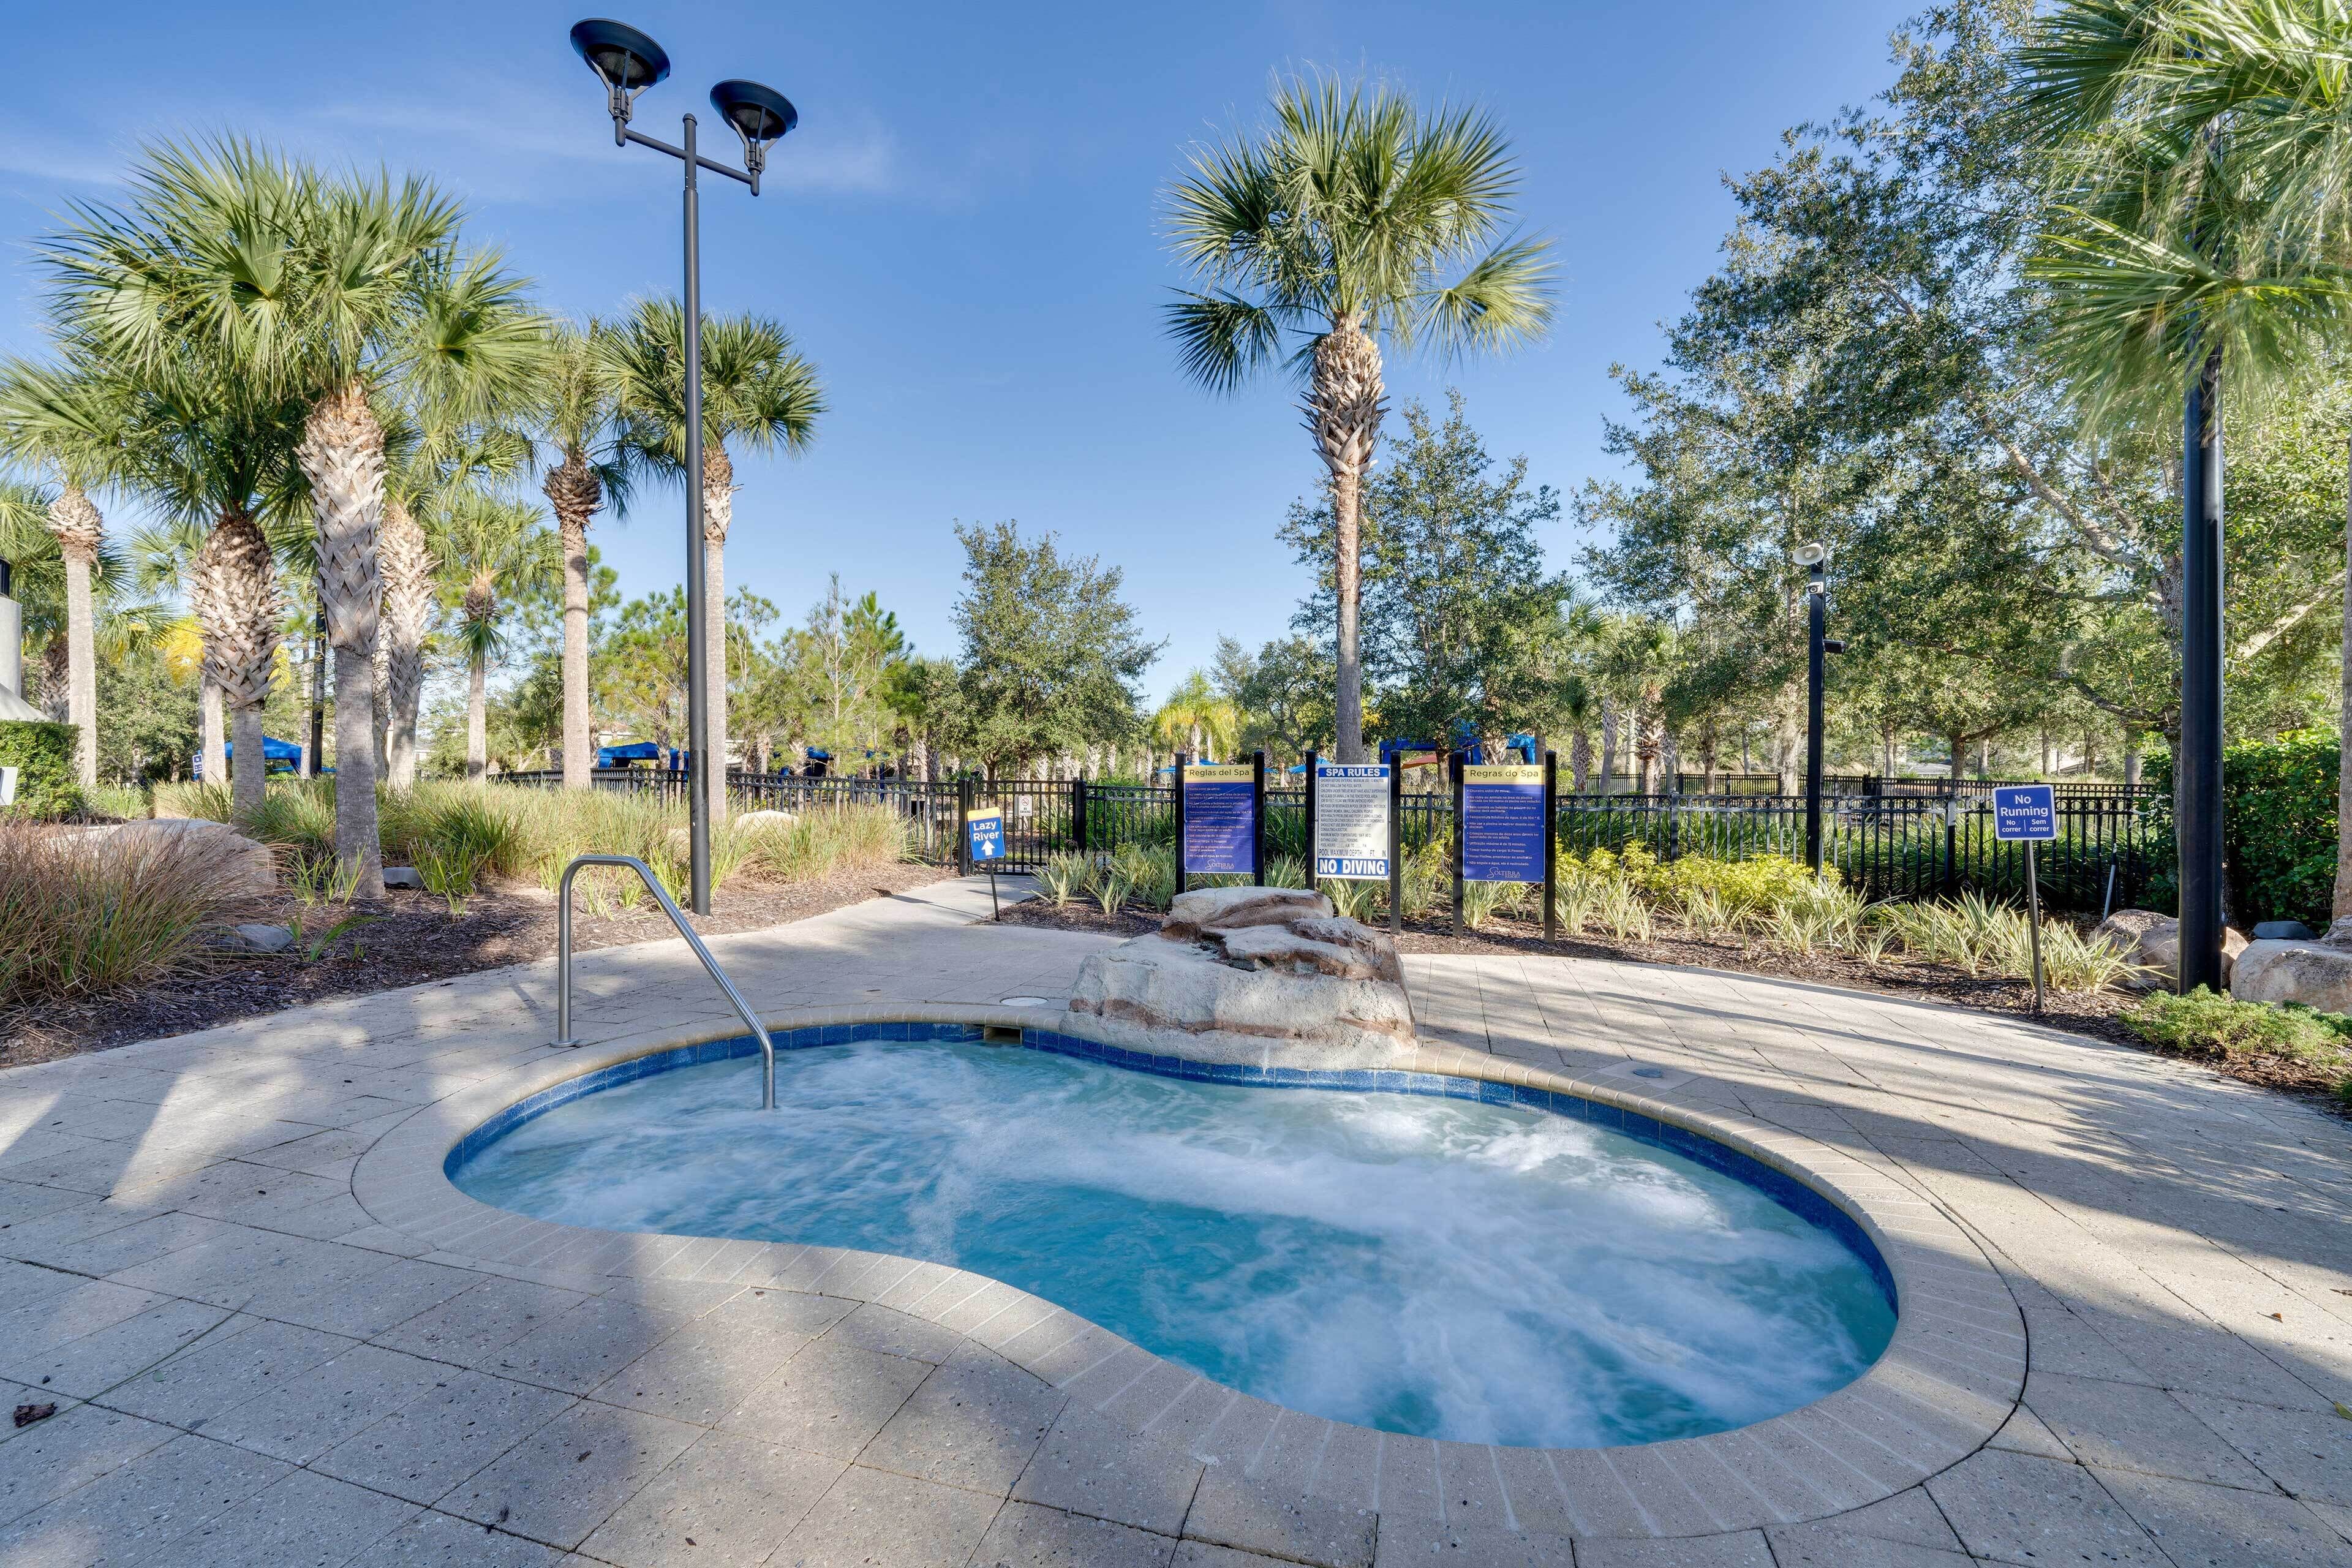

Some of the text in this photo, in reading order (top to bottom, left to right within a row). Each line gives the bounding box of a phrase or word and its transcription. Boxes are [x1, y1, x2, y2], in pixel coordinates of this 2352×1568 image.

[1325, 768, 1381, 777] SPA RULES
[2015, 795, 2031, 804] No
[2000, 806, 2048, 817] Running
[973, 821, 997, 831] Lazy
[973, 831, 1000, 842] River
[1319, 859, 1385, 875] NO DIVING
